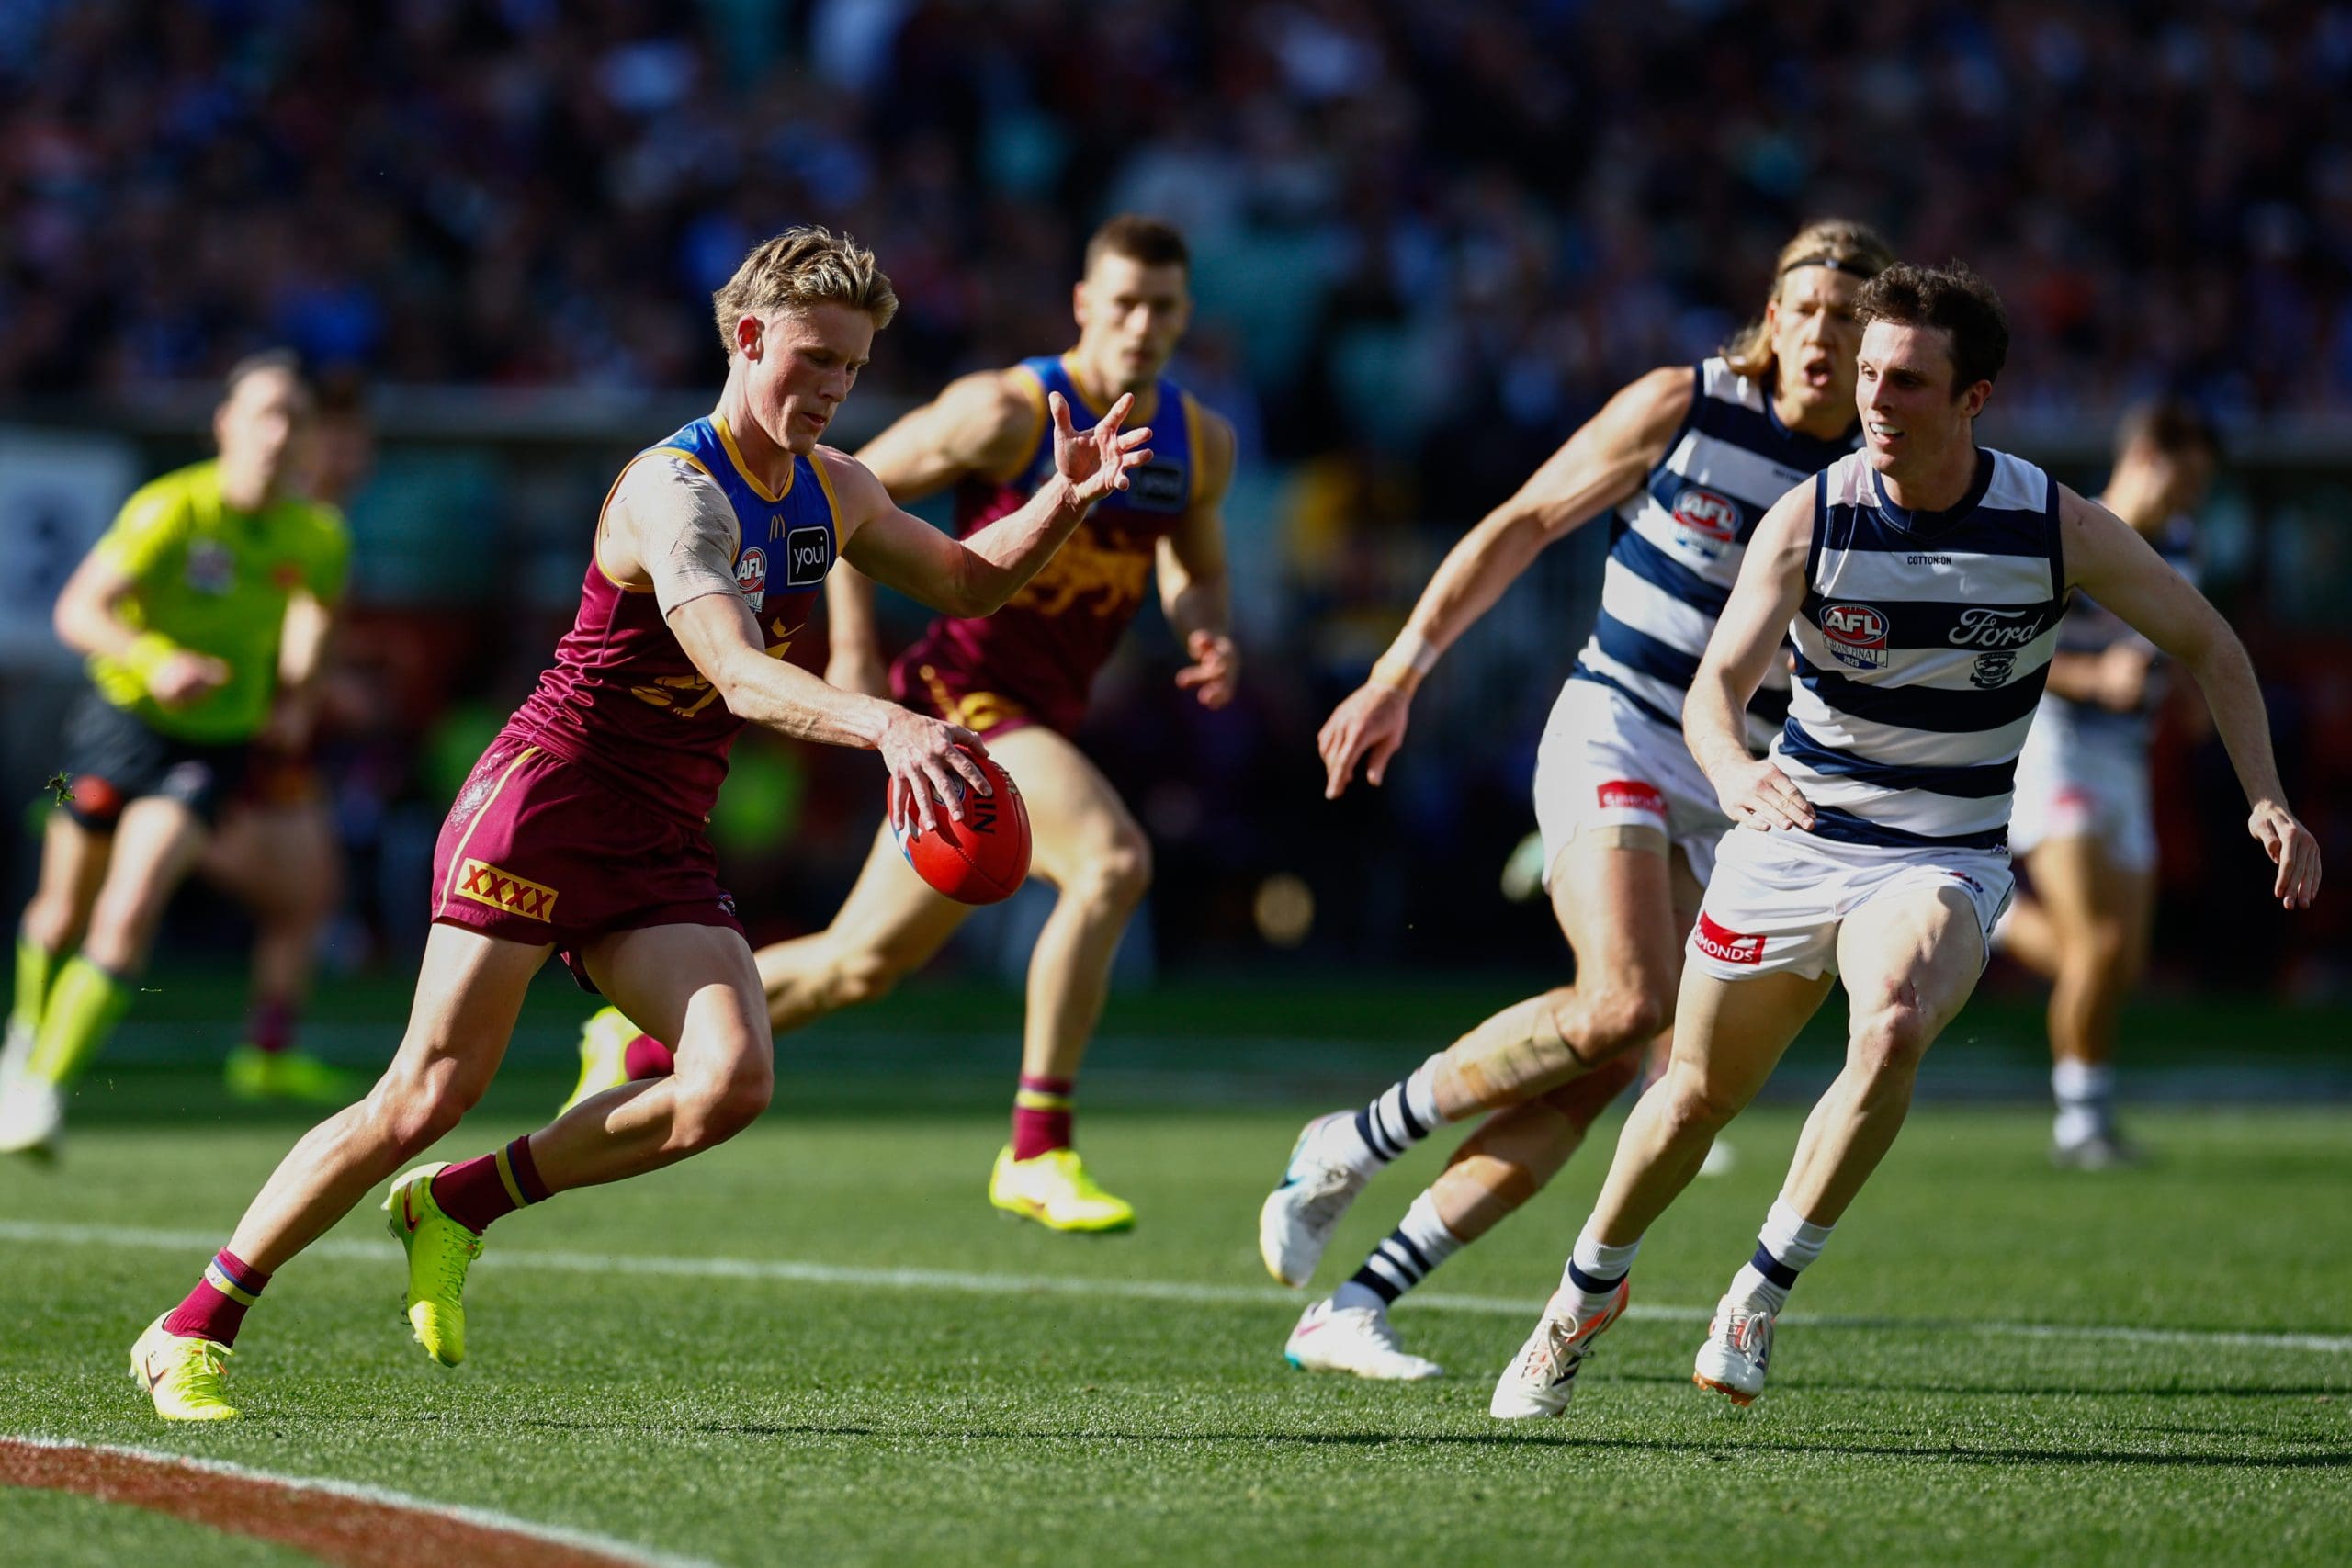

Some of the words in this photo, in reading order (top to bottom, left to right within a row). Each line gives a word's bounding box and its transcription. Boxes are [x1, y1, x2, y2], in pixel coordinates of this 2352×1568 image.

[736, 557, 763, 581] AFL
[794, 536, 825, 575] youi
[1825, 610, 1883, 636] AFL
[1948, 608, 2045, 647] Ford
[461, 864, 553, 919] XXXX
